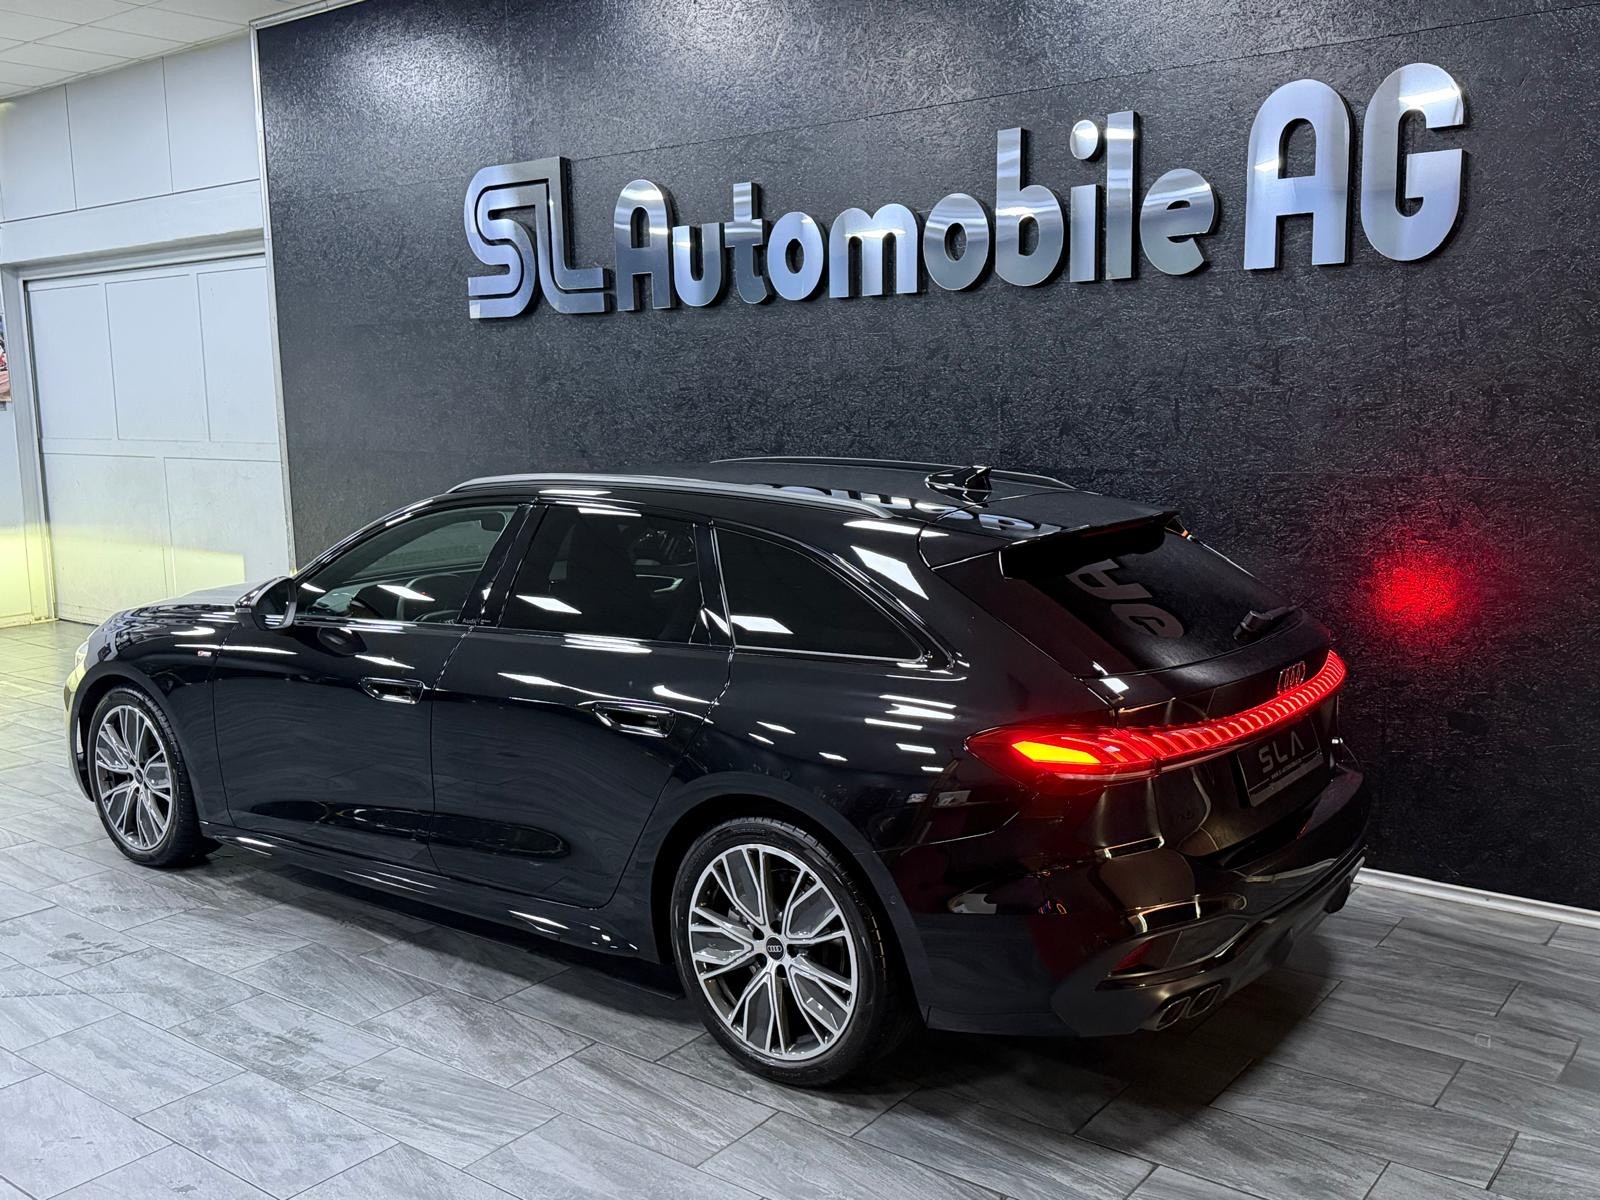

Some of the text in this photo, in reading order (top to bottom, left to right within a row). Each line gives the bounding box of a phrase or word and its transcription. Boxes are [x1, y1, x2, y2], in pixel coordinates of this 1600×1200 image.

[464, 62, 1465, 319] SL Automobile AG
